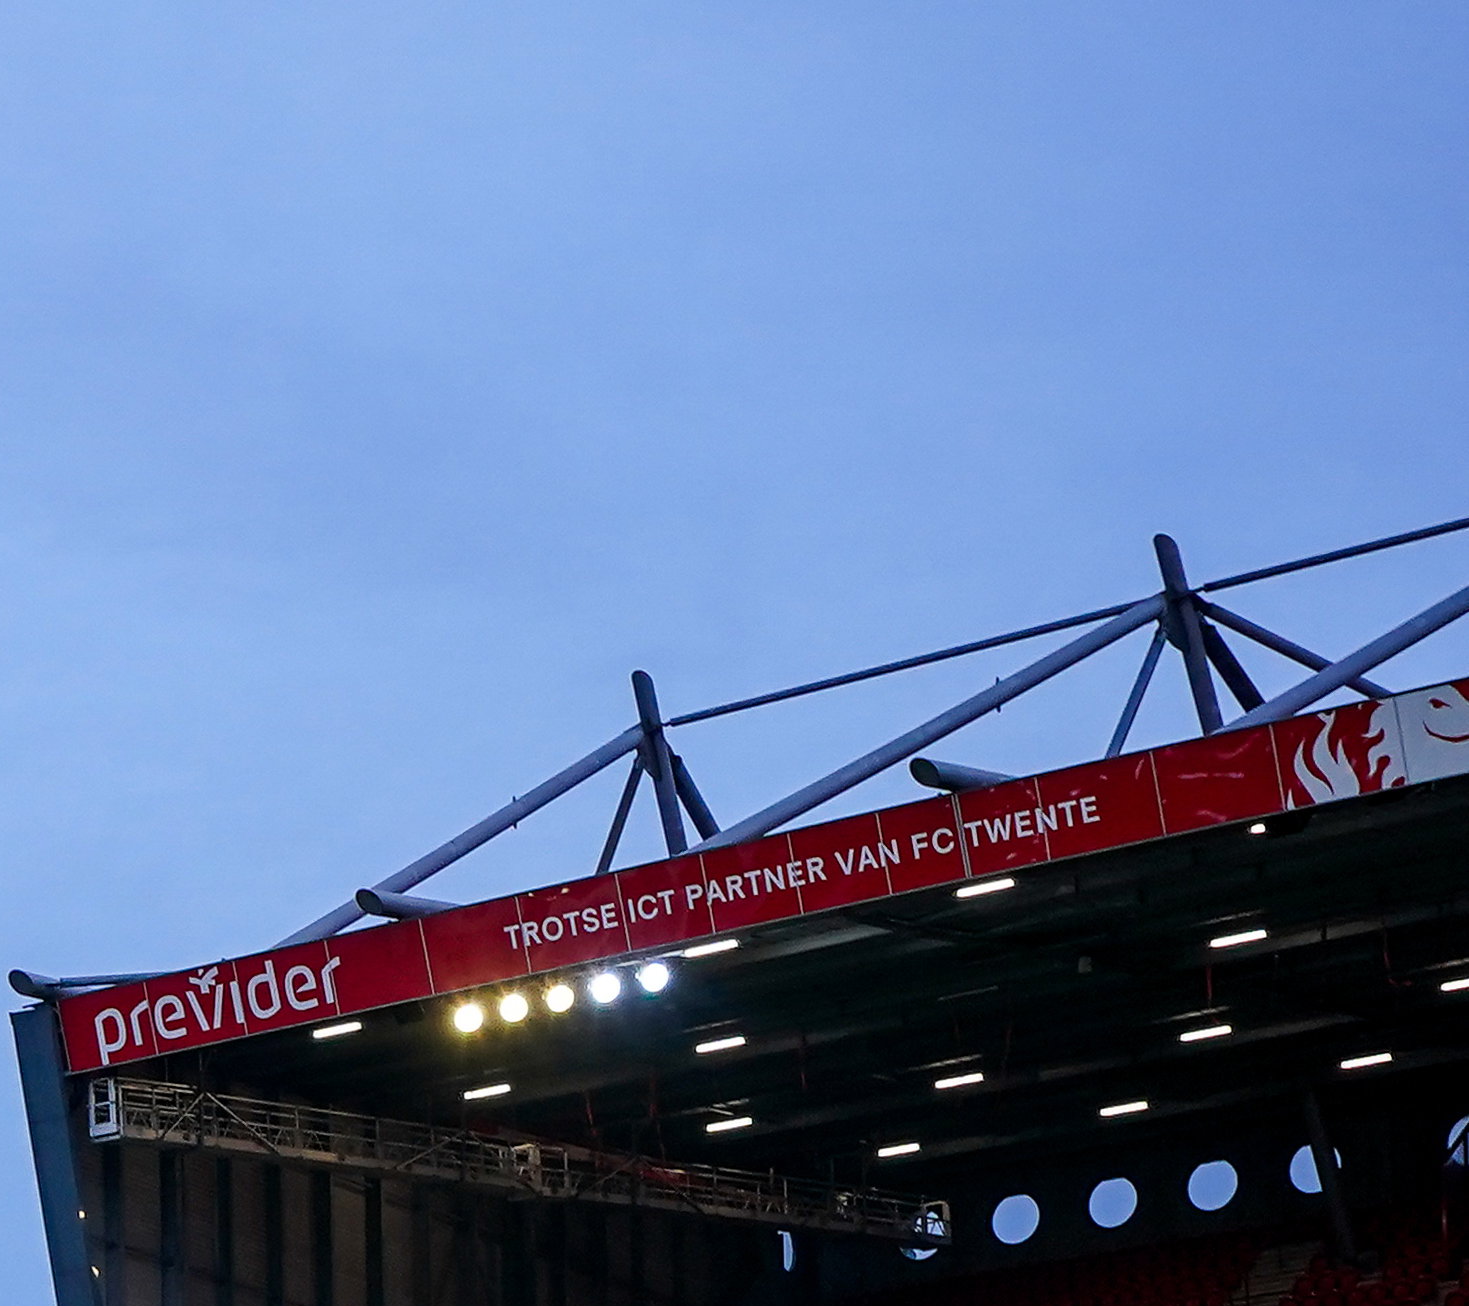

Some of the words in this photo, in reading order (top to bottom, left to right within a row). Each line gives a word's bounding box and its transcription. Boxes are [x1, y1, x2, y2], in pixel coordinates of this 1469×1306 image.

[504, 903, 619, 951] TROTSE
[629, 889, 675, 925] ICT
[686, 857, 825, 911] PARTNER
[835, 840, 901, 878] VAN
[912, 827, 955, 861] FC
[964, 796, 1101, 849] TWENTE
[95, 956, 343, 1066] previder
